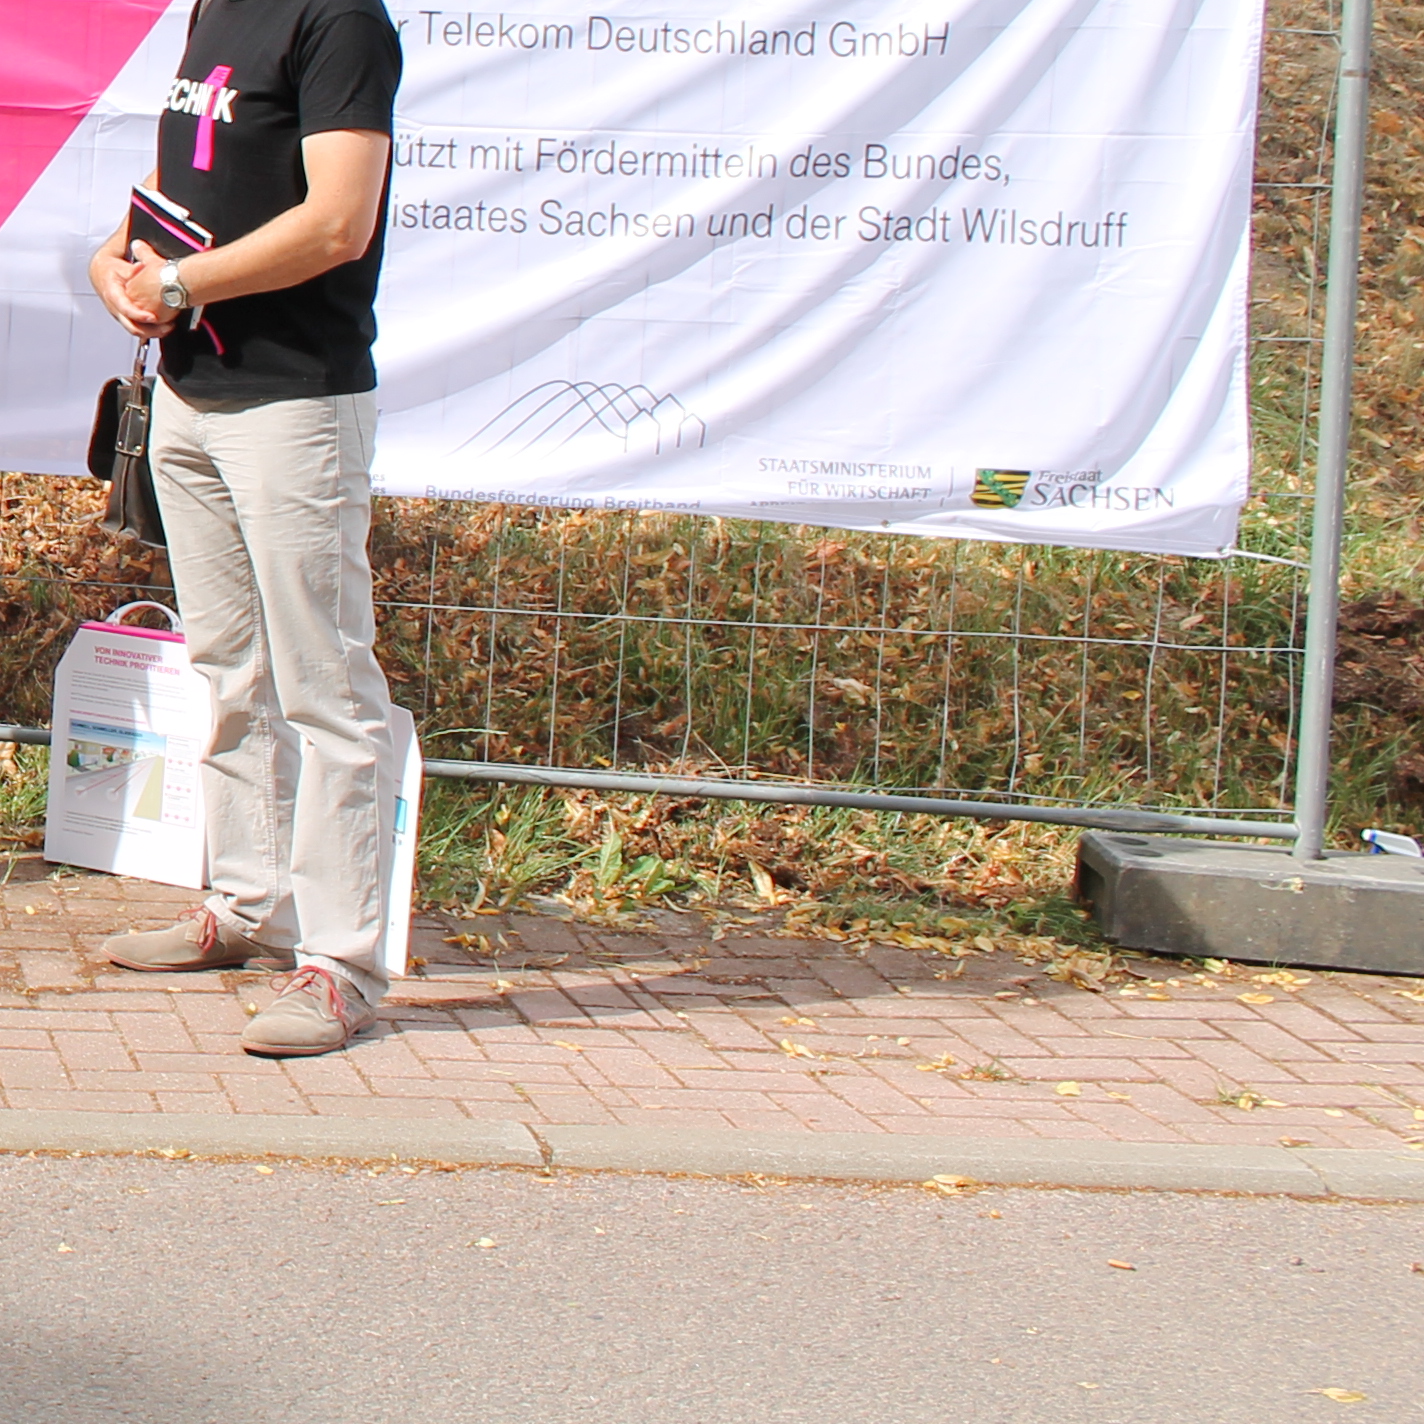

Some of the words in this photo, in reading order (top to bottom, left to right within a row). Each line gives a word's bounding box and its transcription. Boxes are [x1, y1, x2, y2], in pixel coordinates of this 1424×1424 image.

[418, 11, 573, 50] Telekom
[587, 16, 816, 56] Deutschland
[829, 21, 950, 58] GmbH
[394, 135, 457, 169] ützt
[469, 137, 524, 172] mit
[536, 138, 777, 179] Fördermitteln
[789, 144, 851, 178] des
[863, 143, 1010, 186] Bundes,
[392, 194, 528, 233] istaates
[538, 199, 695, 238] Sachsen
[707, 203, 774, 238] und
[786, 204, 847, 241] der
[857, 206, 952, 243] Stadt
[962, 207, 1128, 247] Wilsdruff
[758, 457, 932, 479] STAATSMINISTERIUM
[1038, 470, 1102, 484] Freistaat
[425, 485, 595, 508] Bundesförderung
[787, 478, 820, 495] FÜR
[825, 483, 932, 500] WIRTSCHAFT
[1030, 483, 1175, 511] SACHSEN
